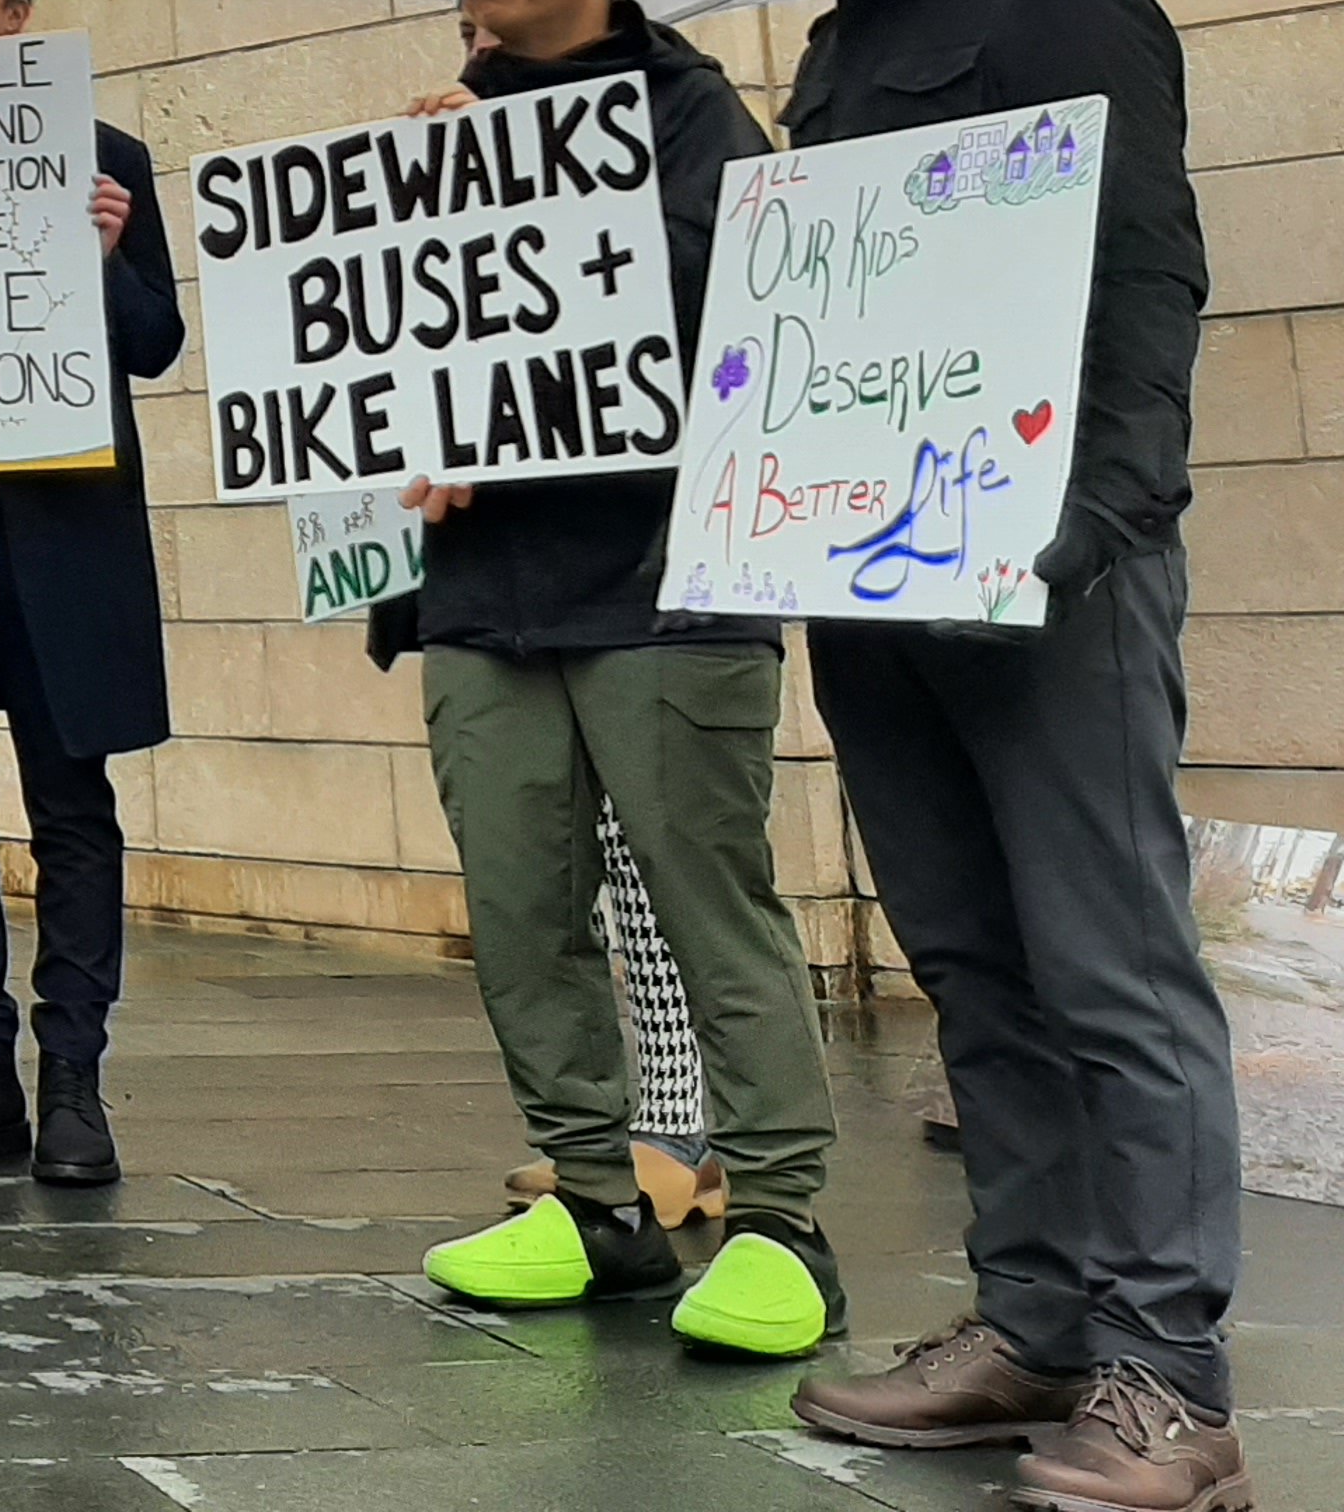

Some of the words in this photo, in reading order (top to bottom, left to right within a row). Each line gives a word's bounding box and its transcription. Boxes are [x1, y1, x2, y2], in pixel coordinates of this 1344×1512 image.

[197, 80, 651, 260] SIDEWALKS
[727, 155, 809, 242] ALL
[288, 224, 561, 364] BUSES
[579, 229, 634, 296] +
[746, 197, 835, 319] OUR
[847, 186, 919, 318] KIDS
[217, 371, 406, 489] BIKE
[432, 334, 680, 469] LANES
[306, 541, 390, 618] AND
[704, 451, 736, 565] A
[827, 426, 1010, 601] Life
